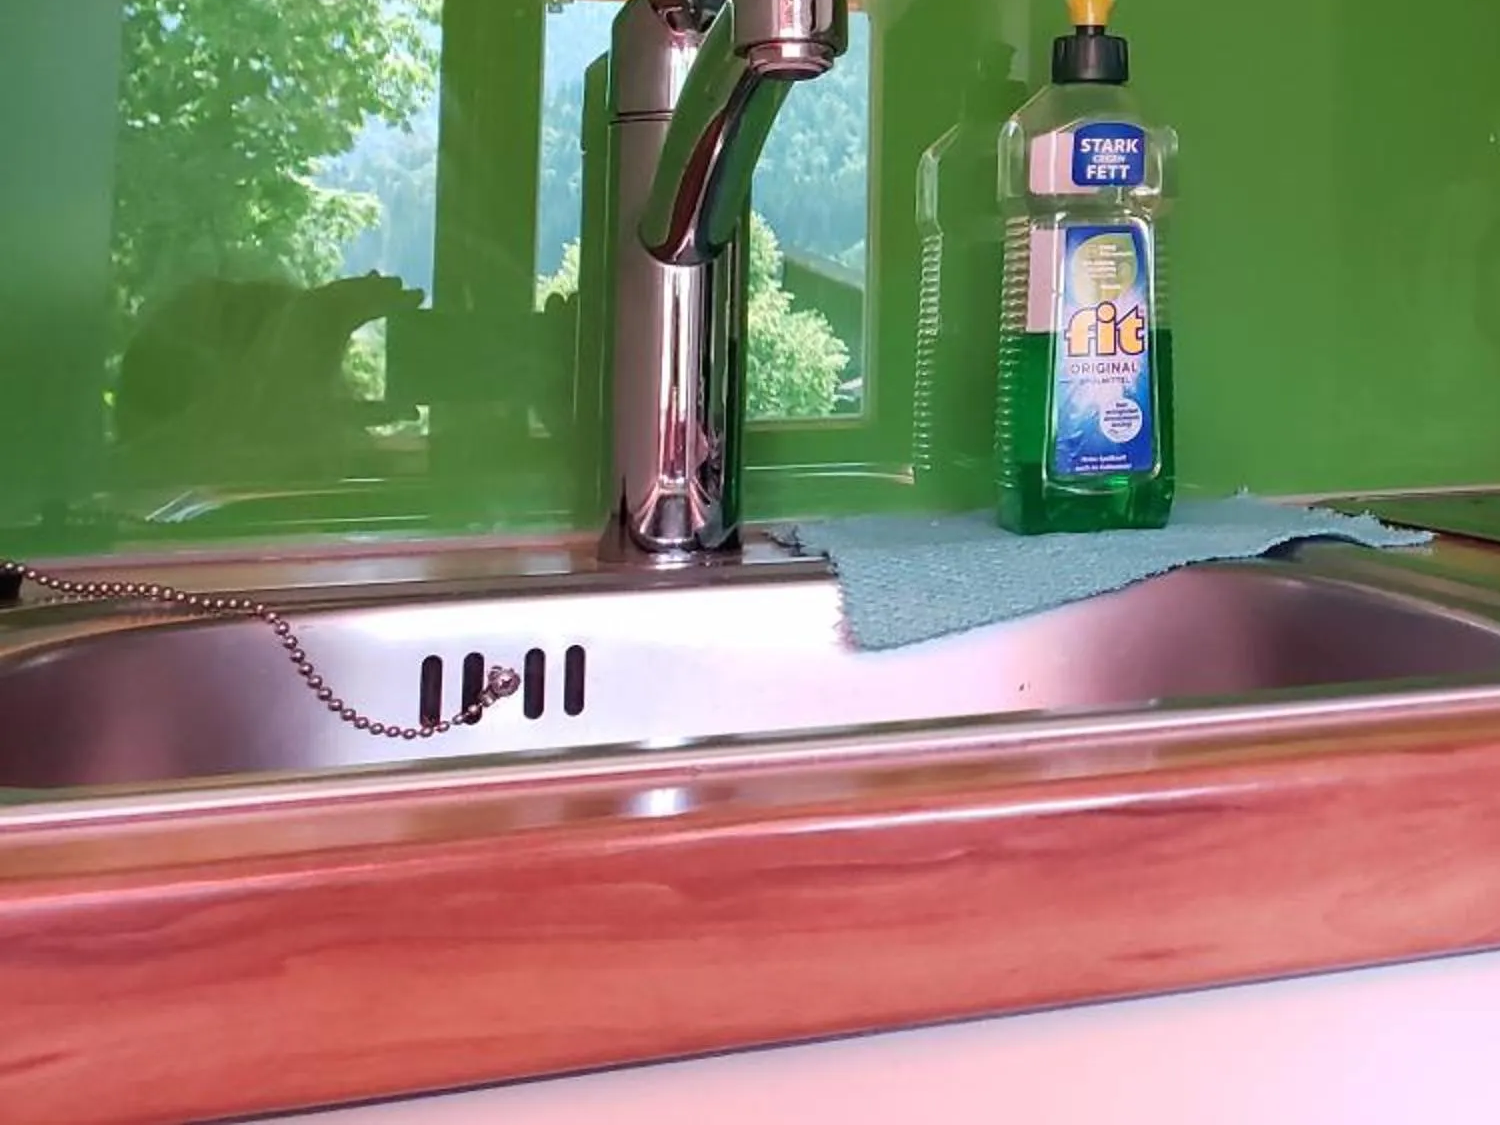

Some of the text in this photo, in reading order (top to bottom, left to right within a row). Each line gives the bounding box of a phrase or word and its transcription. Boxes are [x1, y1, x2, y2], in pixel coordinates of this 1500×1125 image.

[1080, 138, 1139, 154] STARK
[1086, 164, 1131, 180] FETT
[1064, 301, 1145, 357] fit
[1071, 362, 1137, 375] ORIGINAL
